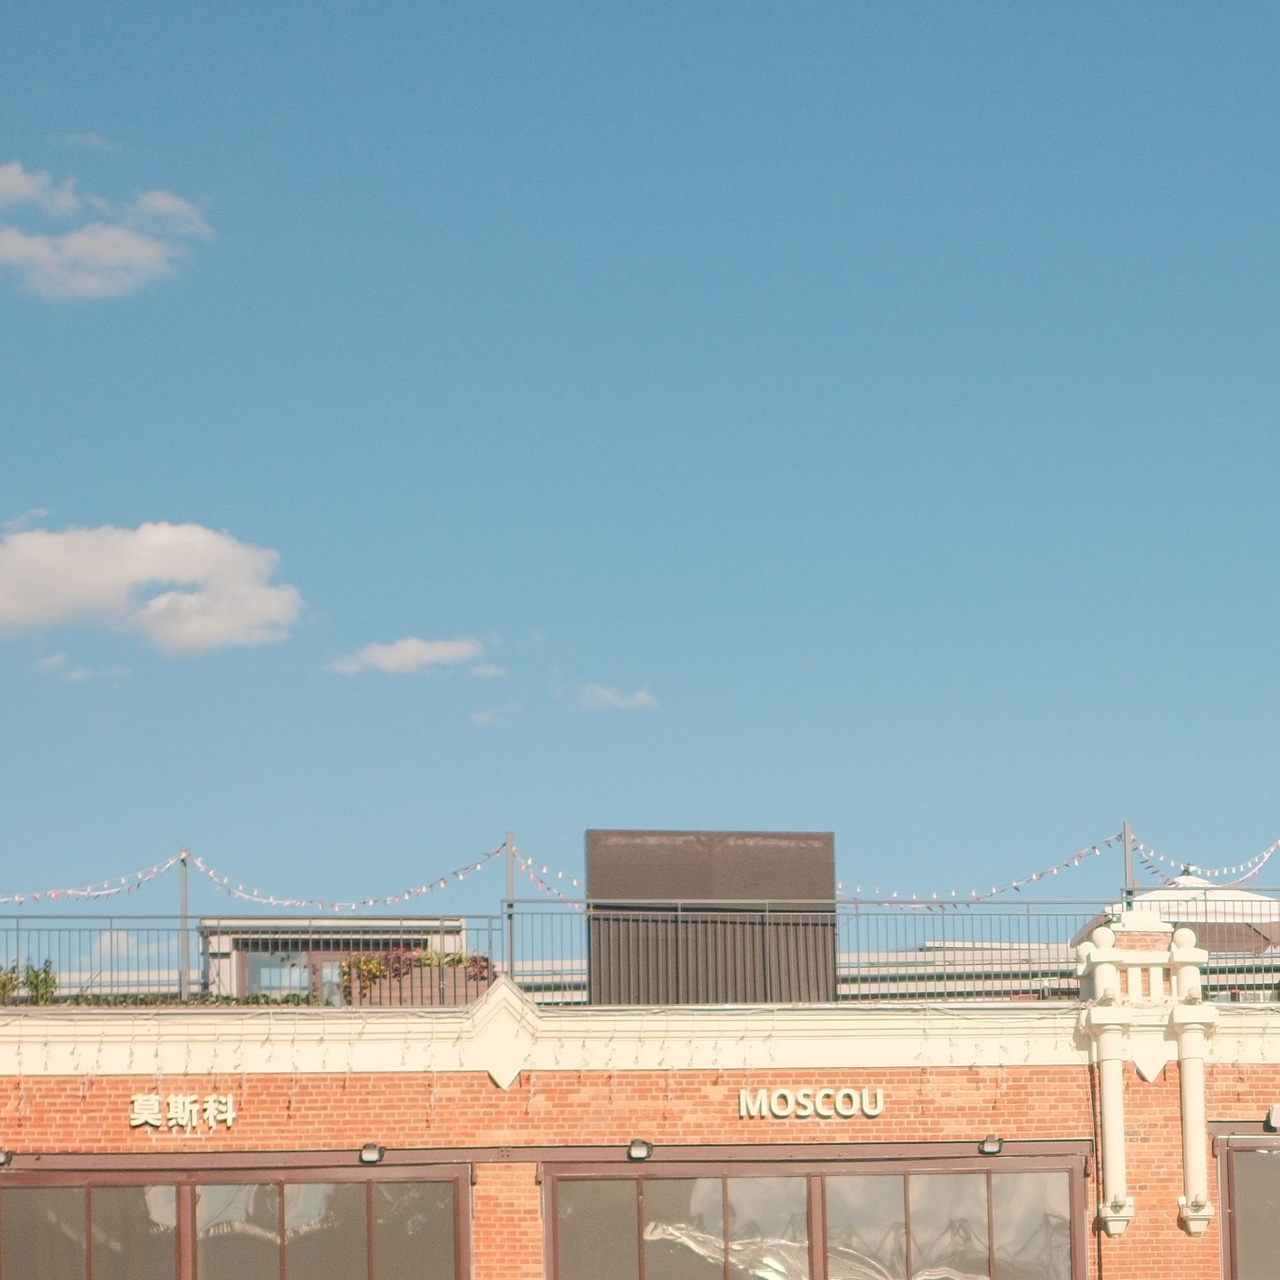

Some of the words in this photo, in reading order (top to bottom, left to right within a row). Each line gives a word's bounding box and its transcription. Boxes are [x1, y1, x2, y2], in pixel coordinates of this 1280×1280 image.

[129, 1093, 237, 1129] 莫斯科
[739, 1088, 885, 1119] MOSCOU
